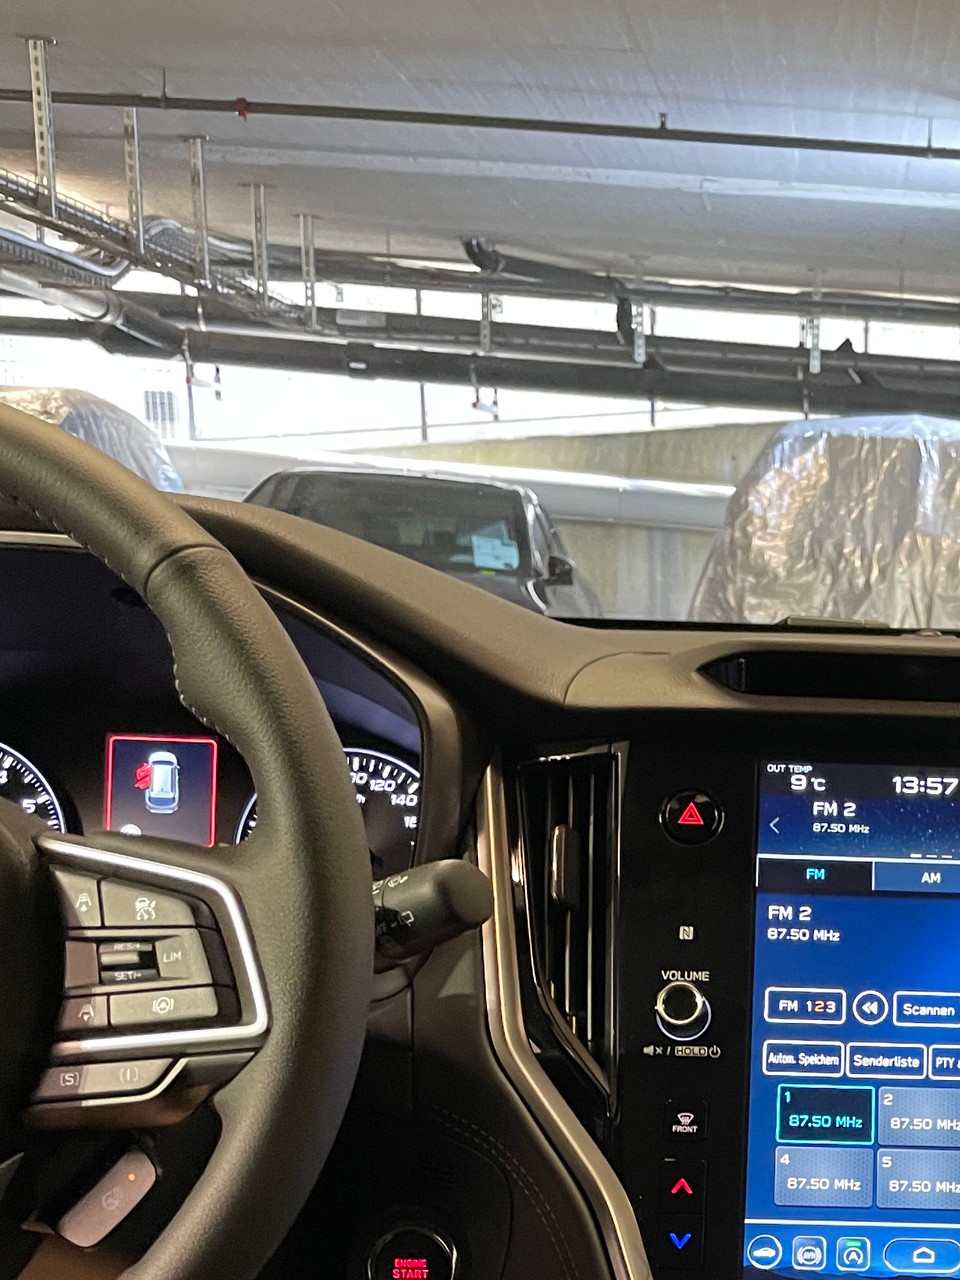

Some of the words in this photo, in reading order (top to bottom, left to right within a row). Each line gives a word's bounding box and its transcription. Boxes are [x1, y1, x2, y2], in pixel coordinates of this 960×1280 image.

[767, 764, 786, 772] OUT
[788, 765, 813, 773] TEMP
[369, 779, 396, 792] 120
[790, 775, 806, 790] 9
[892, 776, 959, 795] 13:57
[22, 798, 37, 814] 5
[390, 793, 418, 807] 140
[813, 802, 837, 816] FM
[843, 803, 856, 817] 2
[813, 823, 846, 833] 87.50
[849, 824, 870, 834] MHz
[806, 868, 825, 880] FM
[921, 872, 941, 883] AM
[768, 906, 792, 920] FM
[799, 907, 812, 921] 2
[767, 929, 809, 941] 87.50
[813, 930, 840, 942] MHz
[163, 950, 182, 963] LIM
[661, 970, 710, 981] VOLUME
[779, 1000, 797, 1011] FM
[903, 1003, 955, 1016] Scannen
[675, 1047, 707, 1055] HOLD
[768, 1052, 796, 1064] Autom.
[853, 1055, 920, 1068] Senderliste
[935, 1057, 954, 1069] PTY
[784, 1091, 790, 1103] 1
[884, 1094, 893, 1105] 2
[789, 1115, 831, 1128] 87.50
[836, 1117, 862, 1129] MHz
[891, 1118, 932, 1130] 87.50
[672, 1125, 698, 1133] FRONT
[780, 1154, 790, 1165] 4
[882, 1156, 892, 1167] 5
[787, 1178, 829, 1190] 87.50
[834, 1179, 861, 1191] MHz
[889, 1181, 931, 1193] 87.50
[394, 1259, 427, 1268] ENGINE
[392, 1269, 429, 1279] START
